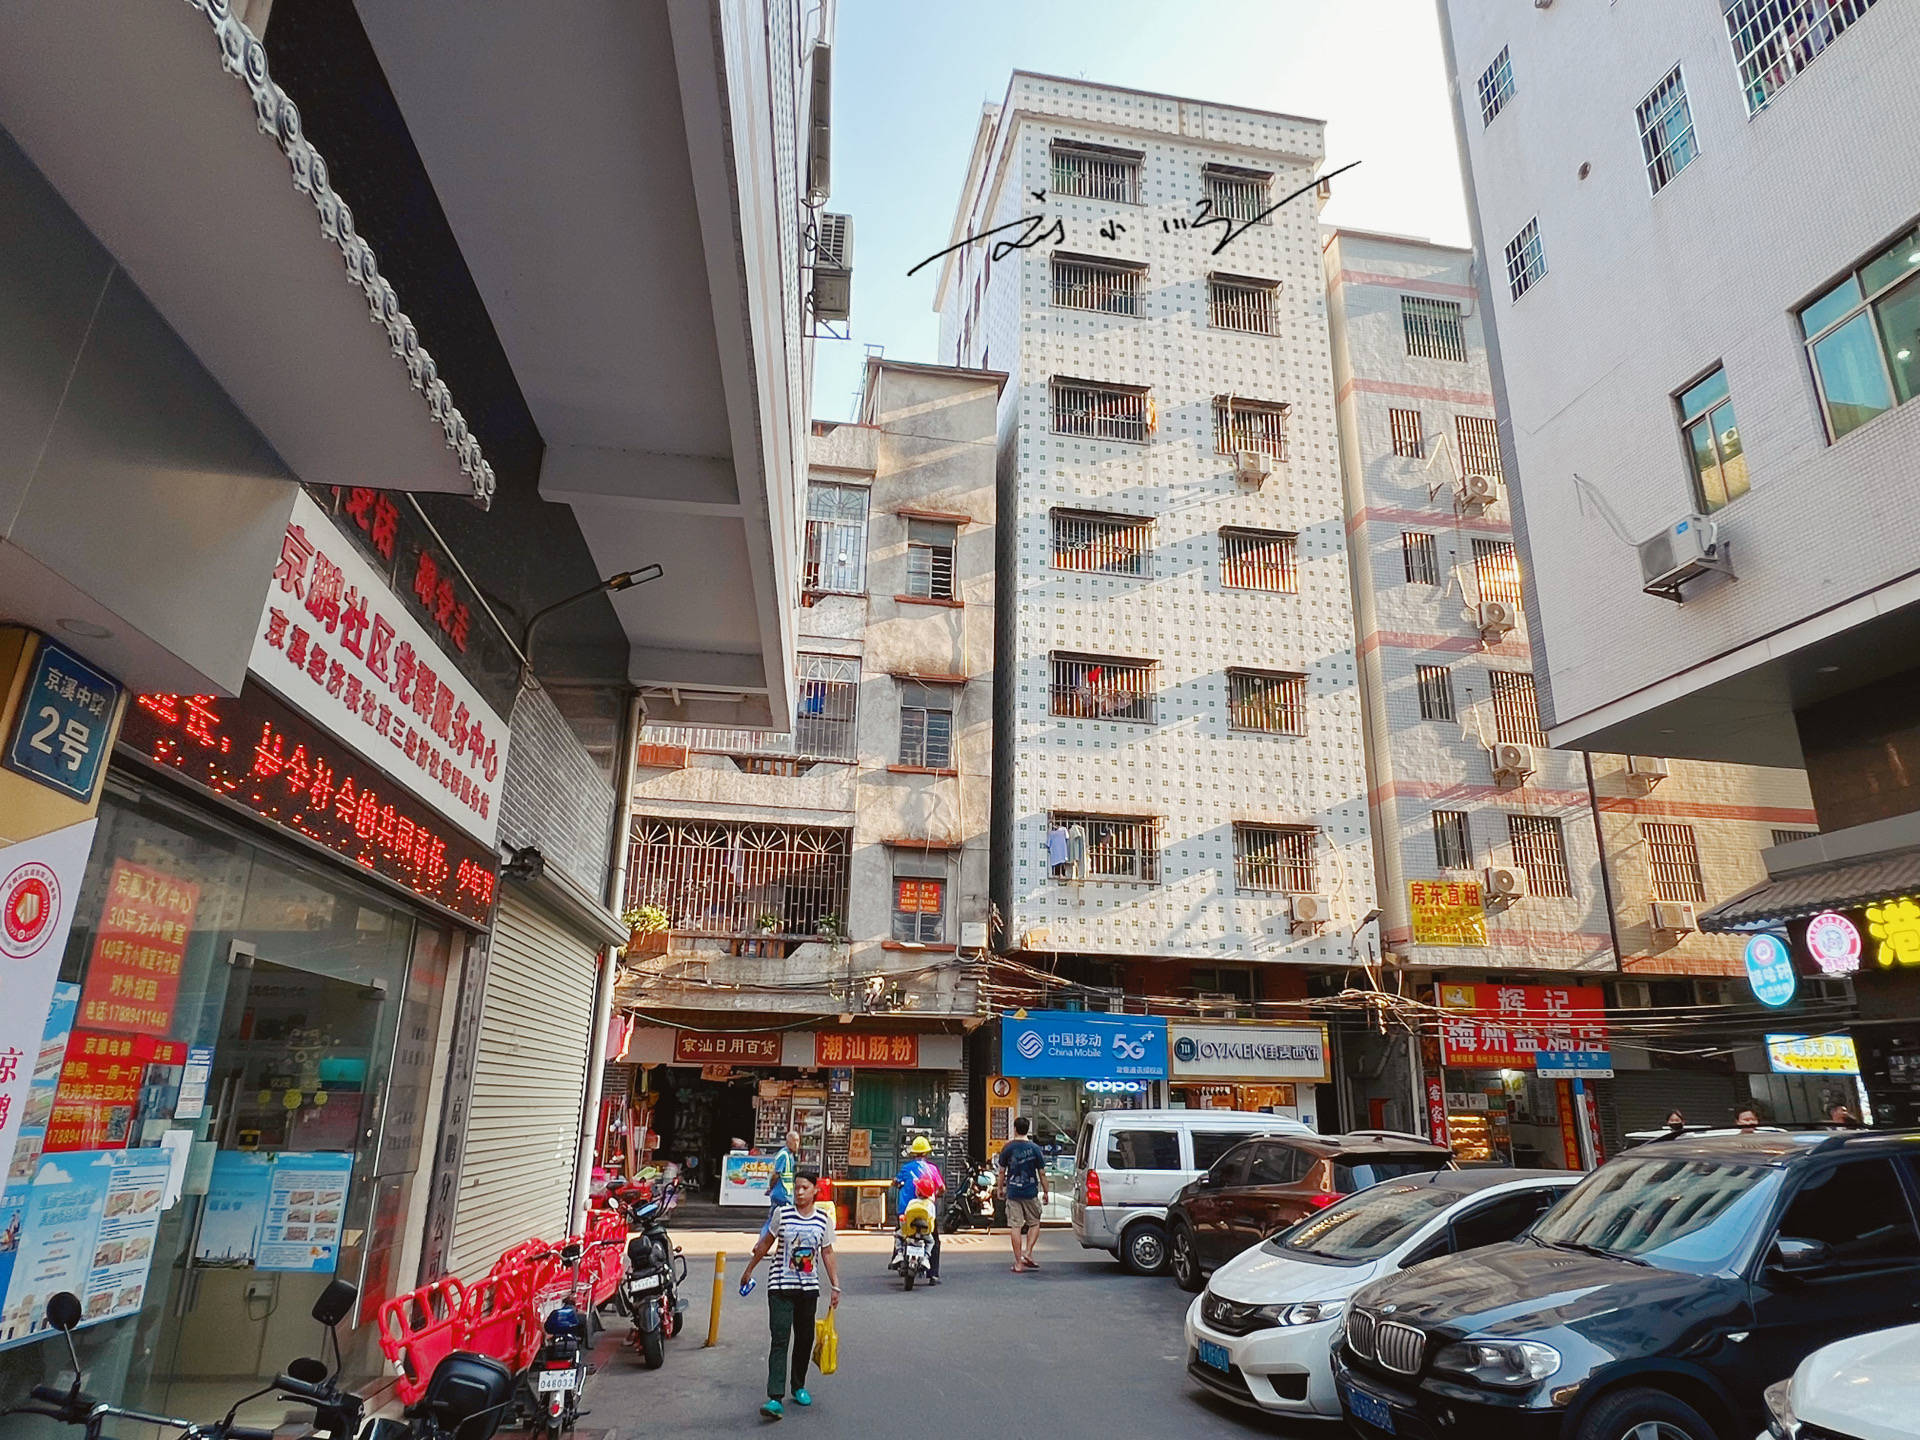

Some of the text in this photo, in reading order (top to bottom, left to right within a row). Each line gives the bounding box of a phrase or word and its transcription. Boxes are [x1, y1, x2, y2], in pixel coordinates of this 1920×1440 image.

[273, 525, 498, 782] 京鹏社区党群服务中心
[44, 667, 106, 716] 京溪中路
[30, 706, 90, 771] 2号
[1411, 881, 1480, 906] 房东直租
[108, 906, 187, 945] 30平方小课室
[1498, 987, 1573, 1018] 辉记
[682, 1038, 776, 1055] 京汕日用百货
[822, 1034, 912, 1061] 潮汕肠粉
[1048, 1033, 1102, 1046] 中国移动
[1048, 1047, 1102, 1058] China Mobile
